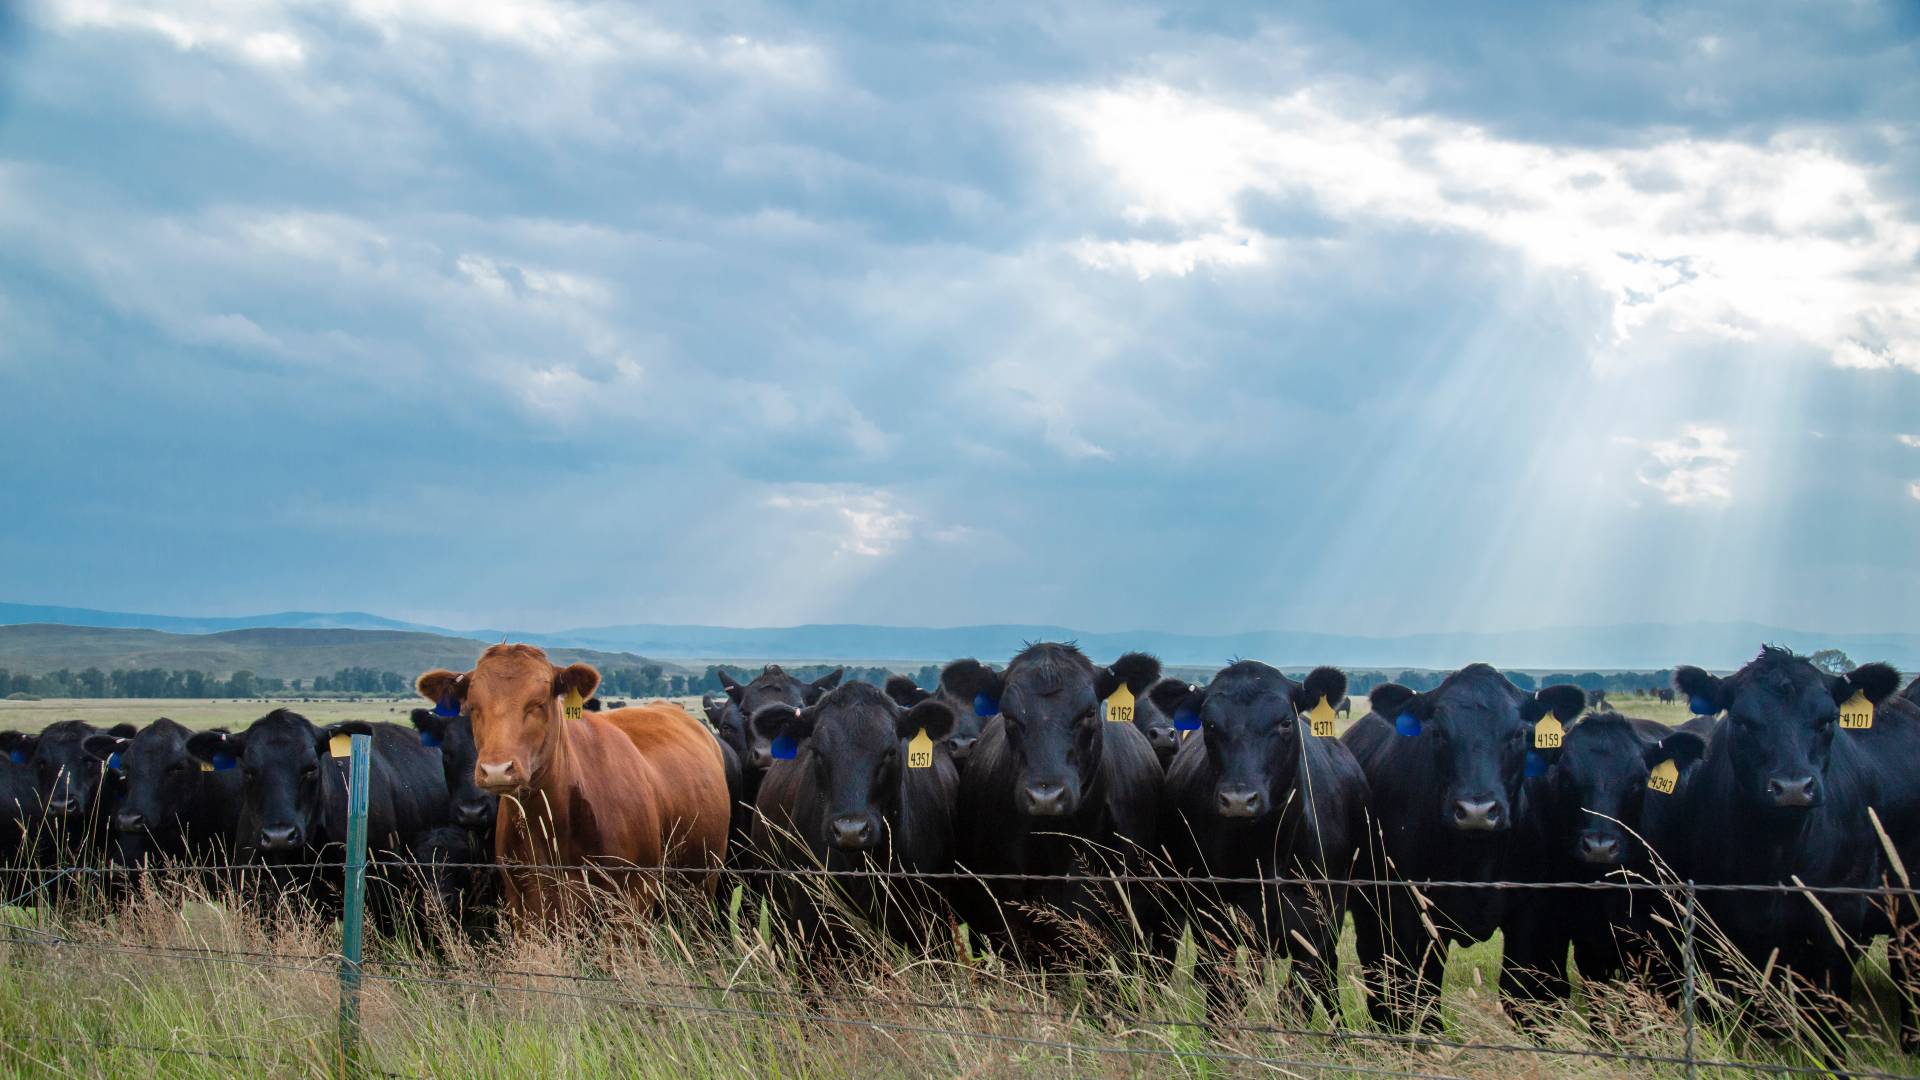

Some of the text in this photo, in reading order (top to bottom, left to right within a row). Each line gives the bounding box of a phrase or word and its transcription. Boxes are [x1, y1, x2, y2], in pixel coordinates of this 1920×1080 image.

[1111, 706, 1132, 721] 4162
[1843, 713, 1869, 727] 4101
[1313, 721, 1333, 736] 4371
[1538, 733, 1559, 747] 4159
[911, 752, 930, 767] 4351
[1651, 775, 1673, 792] 4343
